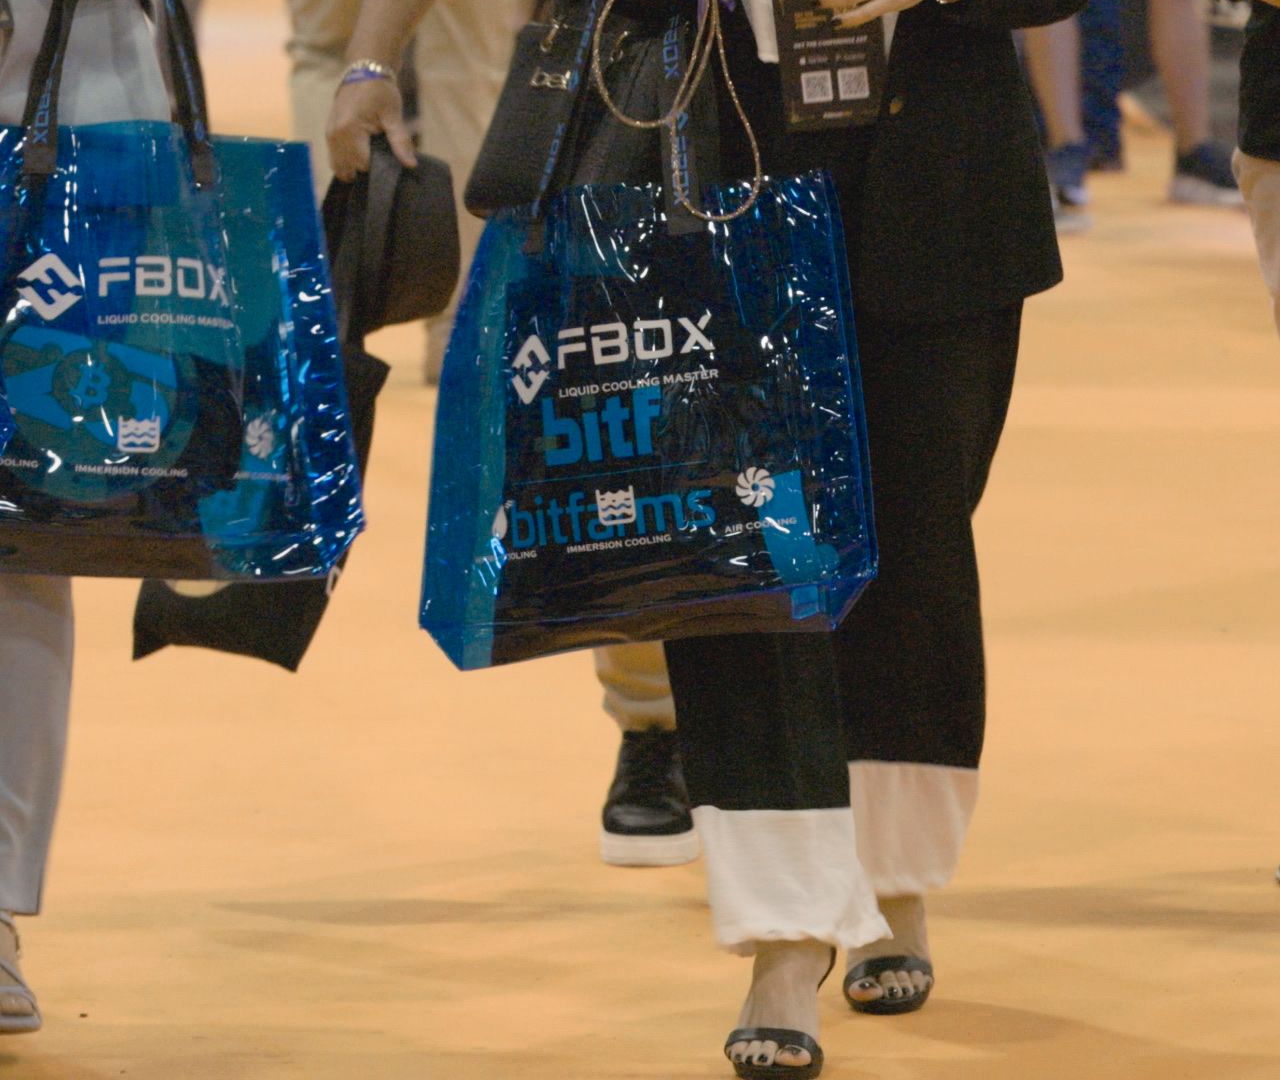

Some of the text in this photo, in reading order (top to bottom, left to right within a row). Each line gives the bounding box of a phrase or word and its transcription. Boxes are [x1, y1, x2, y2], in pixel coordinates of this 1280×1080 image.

[98, 256, 230, 307] FBOX
[97, 314, 137, 325] LIQUID
[140, 313, 196, 325] COOLING
[557, 315, 716, 370] FBOX
[558, 368, 719, 398] LIQUID COOLING MASTER
[75, 464, 188, 478] IMMERSION COOLING
[724, 516, 798, 534] AIR COOING
[566, 534, 672, 554] IMMERSION COOLING
